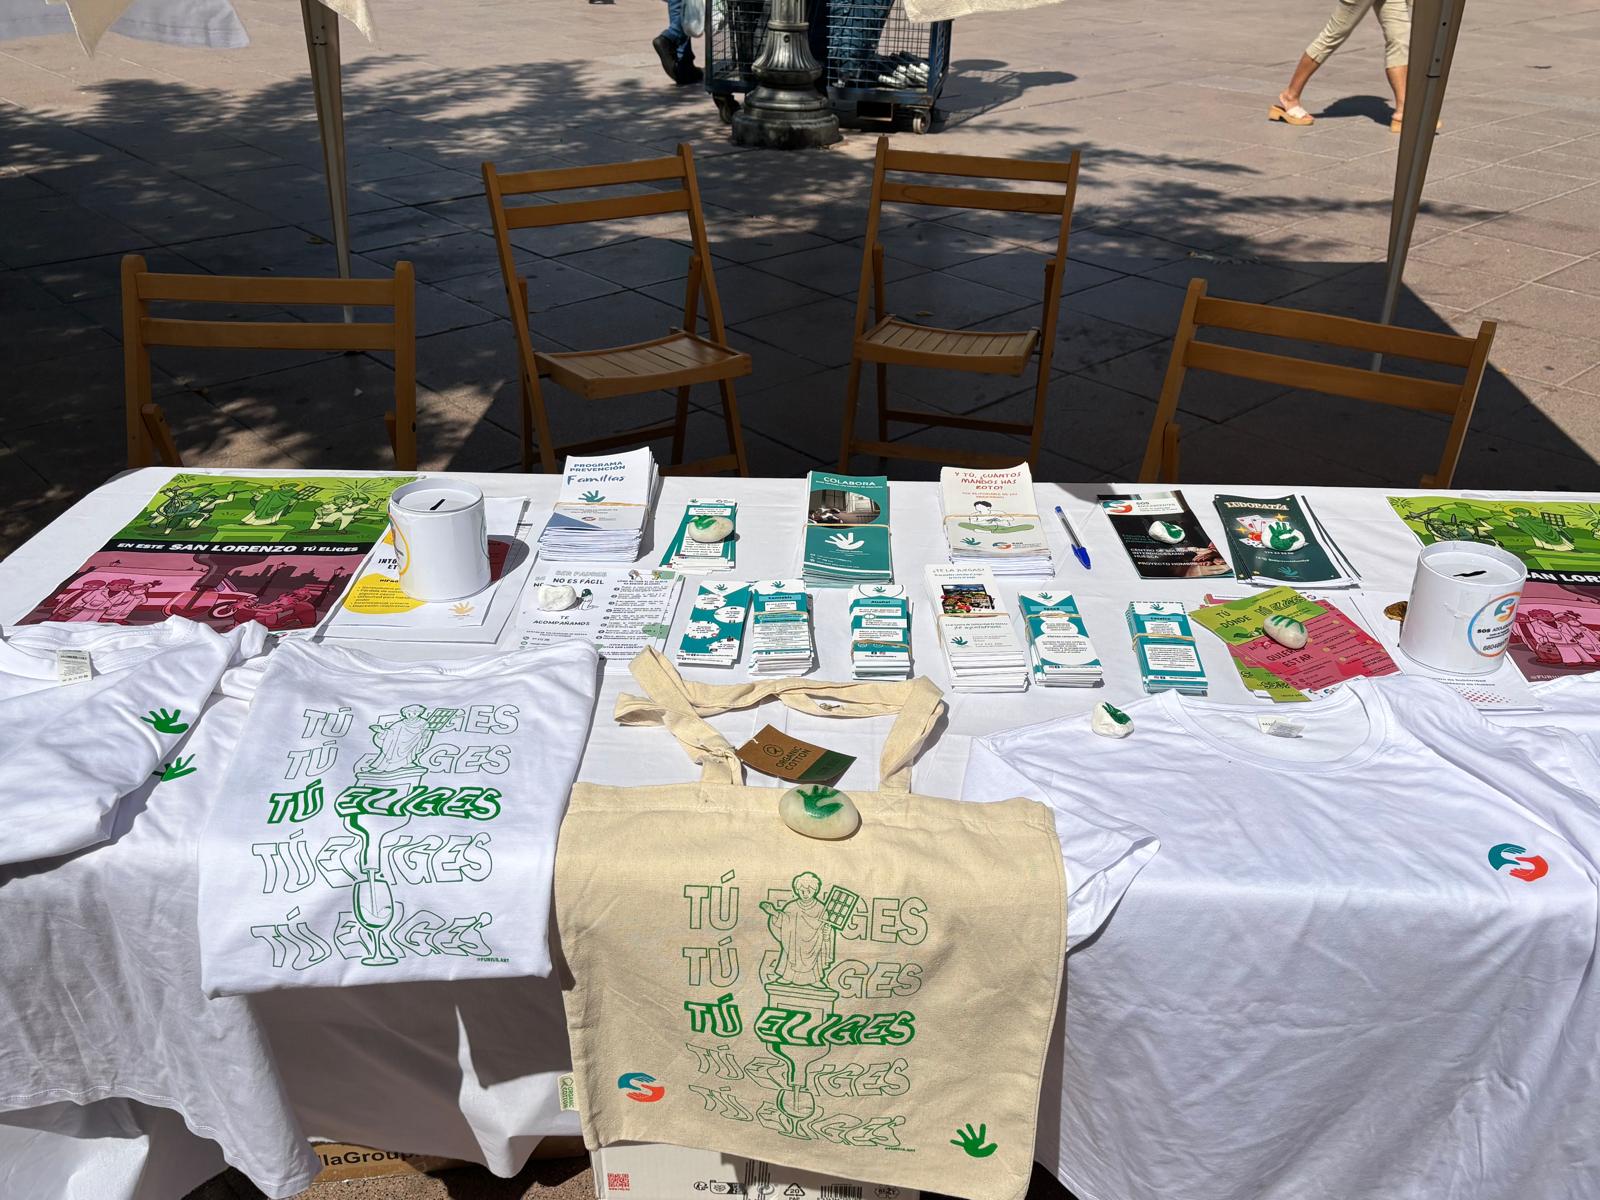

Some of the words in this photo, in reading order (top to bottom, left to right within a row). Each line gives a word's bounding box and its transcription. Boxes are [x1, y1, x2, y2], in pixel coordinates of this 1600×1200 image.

[567, 474, 625, 485] Familias
[824, 477, 876, 486] COLABORA
[1224, 502, 1290, 511] LUDOPATÍA
[169, 544, 208, 552] SAN
[210, 544, 297, 552] LORENZO
[1216, 609, 1231, 618] TÚ
[1220, 614, 1252, 628] DÓNDE
[1282, 654, 1313, 668] ESTAR
[302, 707, 353, 738] TÚ
[284, 740, 338, 780] TÚ
[785, 749, 812, 770] COTTON
[267, 779, 324, 824] TÚ
[334, 786, 502, 819] ELIGES
[251, 829, 316, 893] TÚ
[684, 869, 739, 930] TÚ
[250, 906, 332, 970] TÚ
[683, 936, 739, 987] TÚ
[684, 993, 743, 1038] TÚ
[754, 1007, 916, 1046] ELIGES
[686, 1043, 746, 1080] TÚ
[688, 1085, 754, 1121] TÚ
